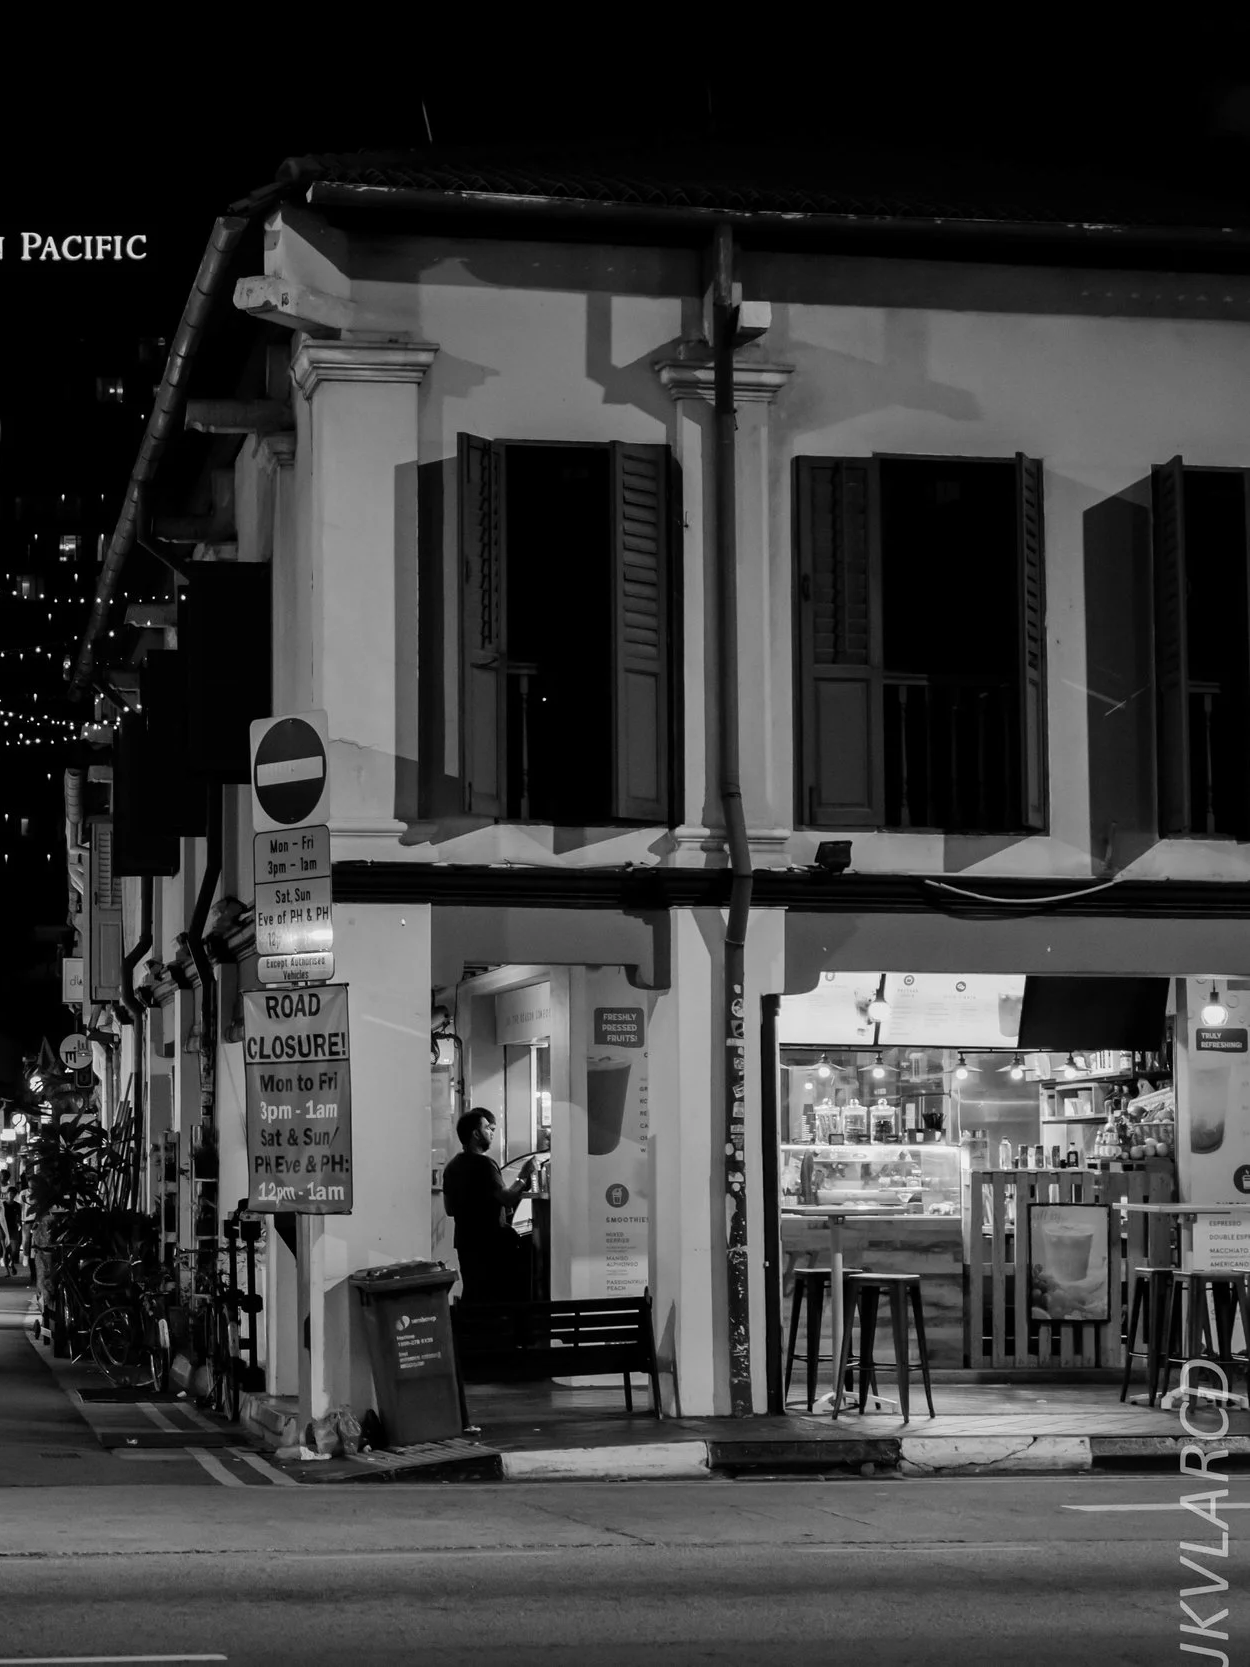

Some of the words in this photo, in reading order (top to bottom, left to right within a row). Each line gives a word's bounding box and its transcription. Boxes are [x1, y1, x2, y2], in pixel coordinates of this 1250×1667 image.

[20, 232, 147, 260] PACIFIC
[269, 839, 289, 854] Mon
[301, 835, 314, 851] Fri
[268, 861, 286, 878] 3pm
[300, 858, 317, 872] 1am
[294, 888, 311, 902] Sun
[258, 913, 273, 927] Eve
[277, 911, 287, 925] of
[290, 908, 303, 923] PH
[306, 908, 313, 921] &
[316, 906, 329, 921] PH
[266, 958, 288, 970] Except
[282, 970, 309, 981] Vehicles
[265, 993, 321, 1019] ROAD
[603, 1013, 637, 1021] FRESHLY
[601, 1024, 638, 1032] PRESSED
[1200, 1032, 1222, 1040] TRULY
[247, 1031, 347, 1060] CLOSURE!
[259, 1074, 293, 1093] Mon
[297, 1075, 314, 1092] to
[318, 1072, 338, 1091] Fri
[260, 1101, 292, 1124] 3pm
[305, 1100, 338, 1119] 1am
[260, 1128, 282, 1147] Sat
[287, 1129, 299, 1146] &
[303, 1126, 339, 1149] Sun/
[254, 1155, 272, 1174] PH
[275, 1155, 301, 1174] Eve
[306, 1156, 317, 1173] &
[320, 1154, 350, 1173] PH:
[258, 1182, 296, 1207] 12pm
[308, 1182, 345, 1201] 1am
